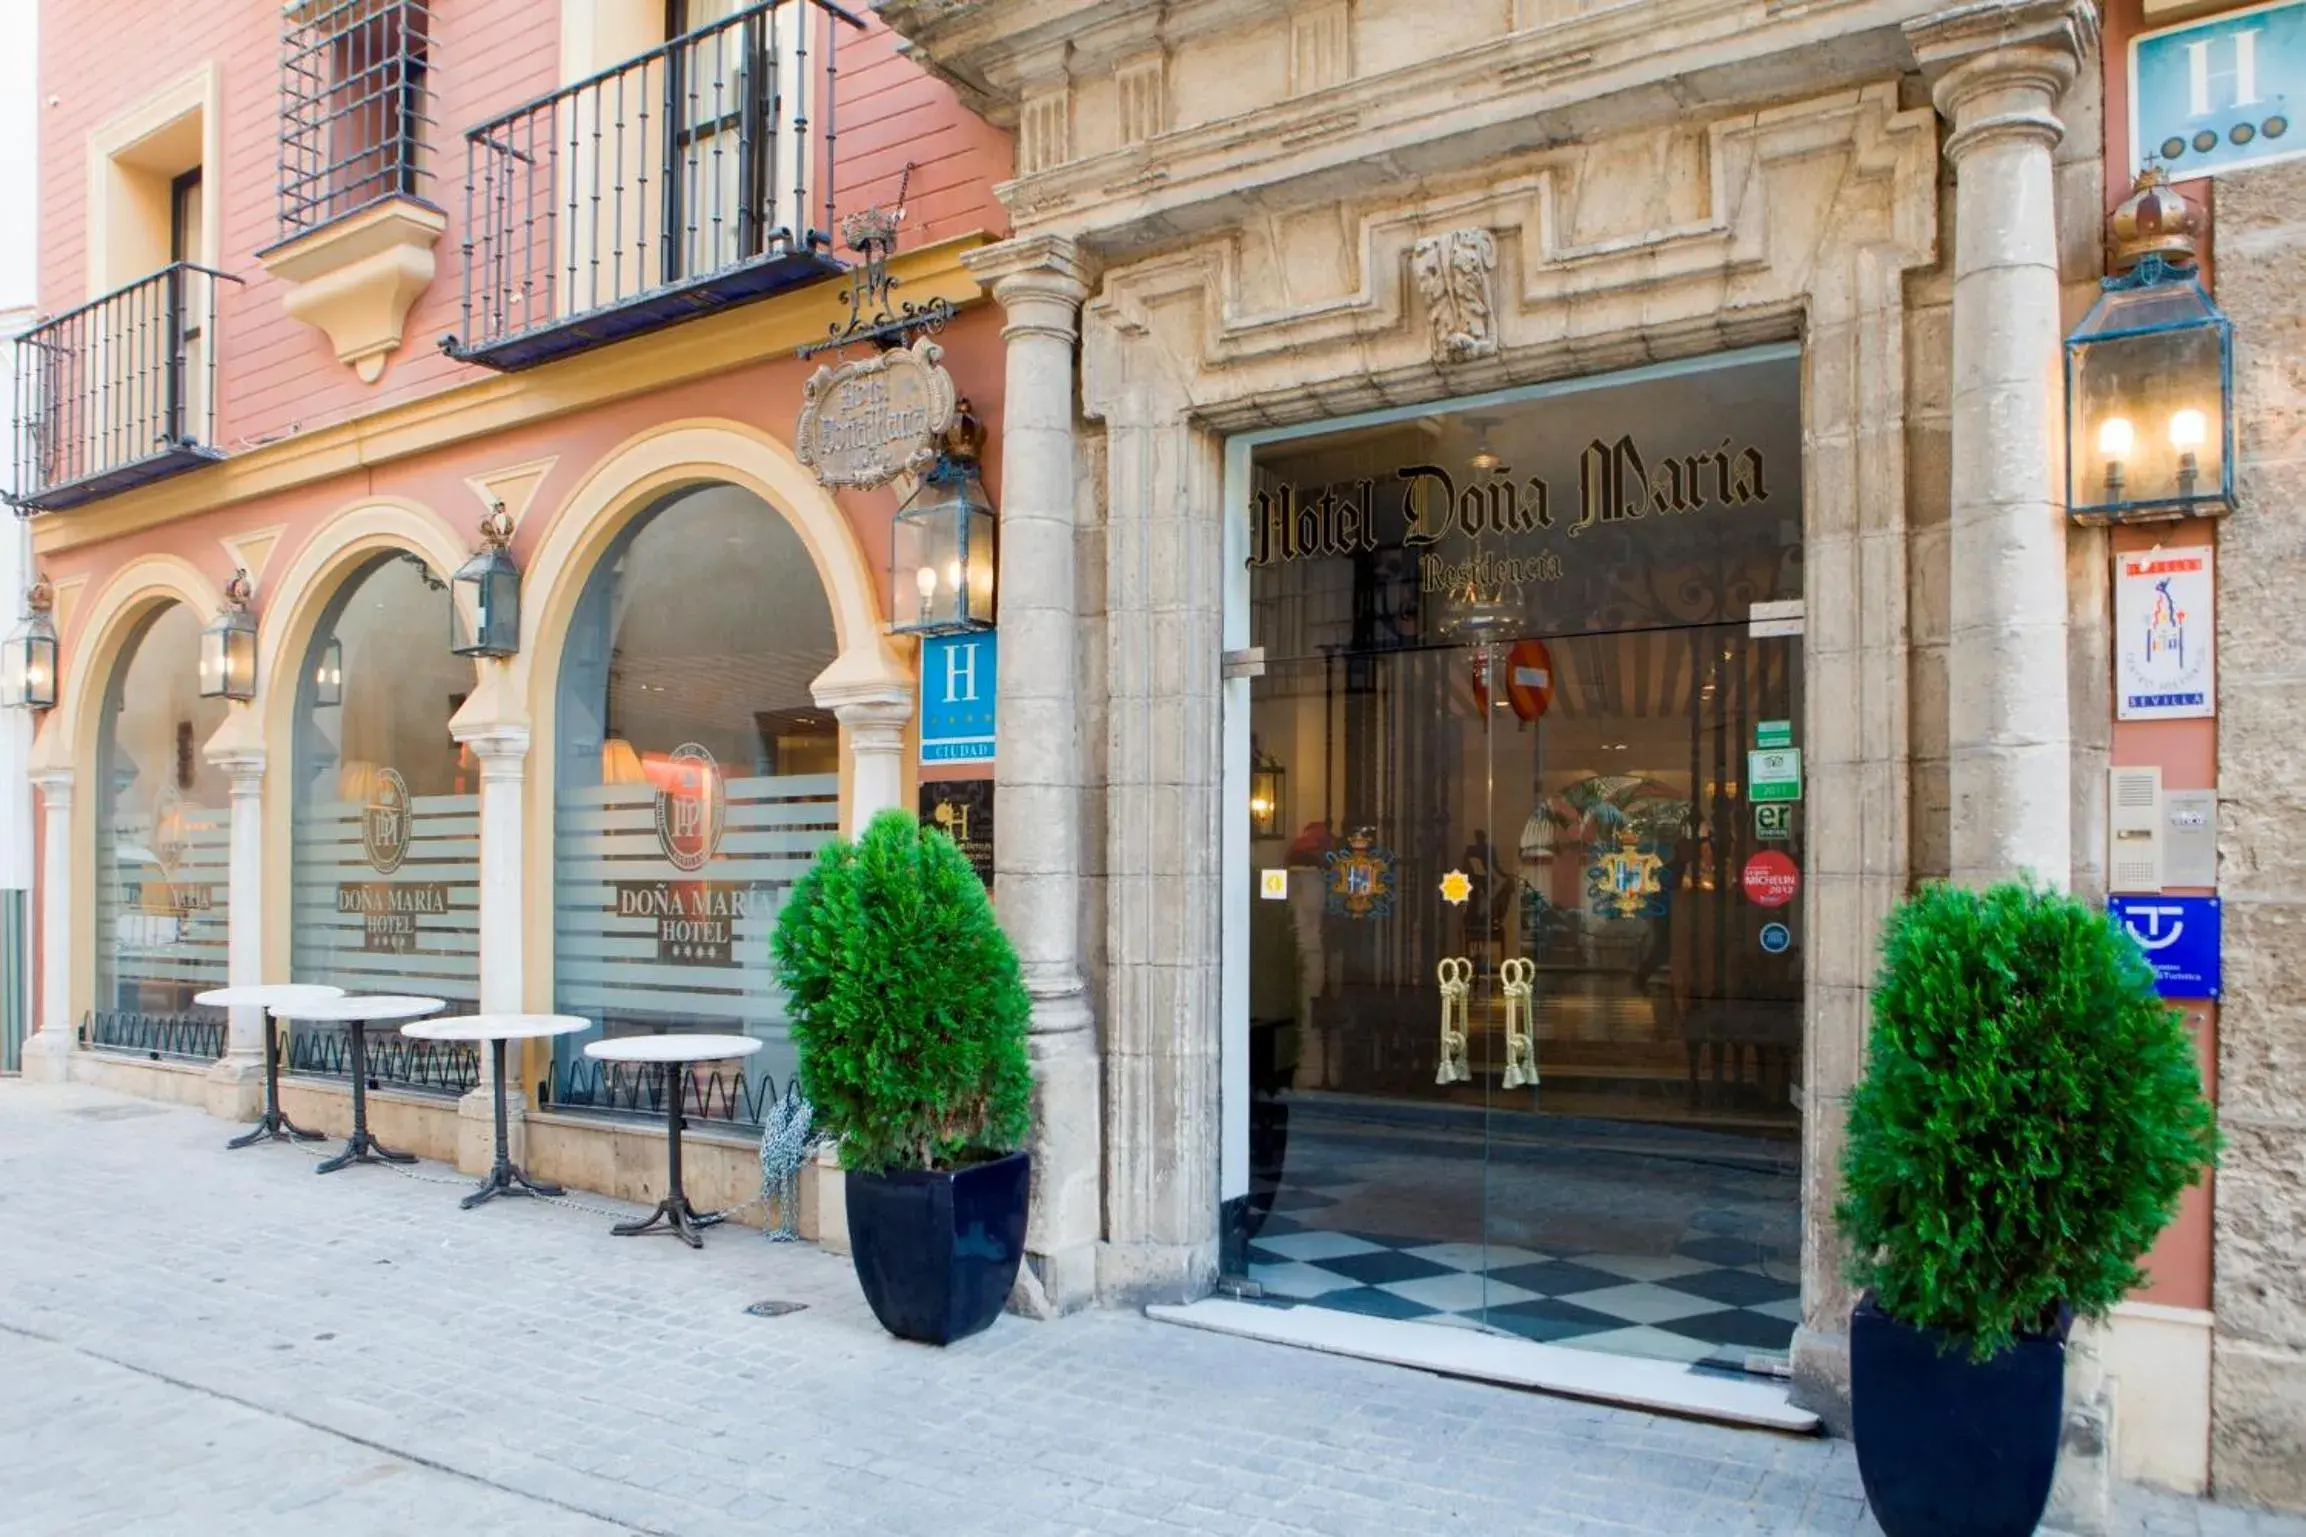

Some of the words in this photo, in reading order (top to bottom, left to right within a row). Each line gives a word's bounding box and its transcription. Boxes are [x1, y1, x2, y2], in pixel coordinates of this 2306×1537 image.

[2183, 27, 2265, 118] H
[1245, 479, 1378, 570] Hotel
[1397, 464, 1555, 548] Doña
[1567, 433, 1771, 539] María
[941, 642, 981, 704] H
[2128, 694, 2204, 707] SEVILLA
[935, 743, 988, 758] CIUDAD
[1758, 806, 1789, 829] er
[1745, 875, 1795, 885] MICHELIN
[340, 884, 385, 911] DOÑA
[389, 883, 445, 913] MARÍA
[621, 883, 684, 915] DOÑA
[368, 915, 414, 934] HOTEL
[662, 919, 729, 943] HOTEL
